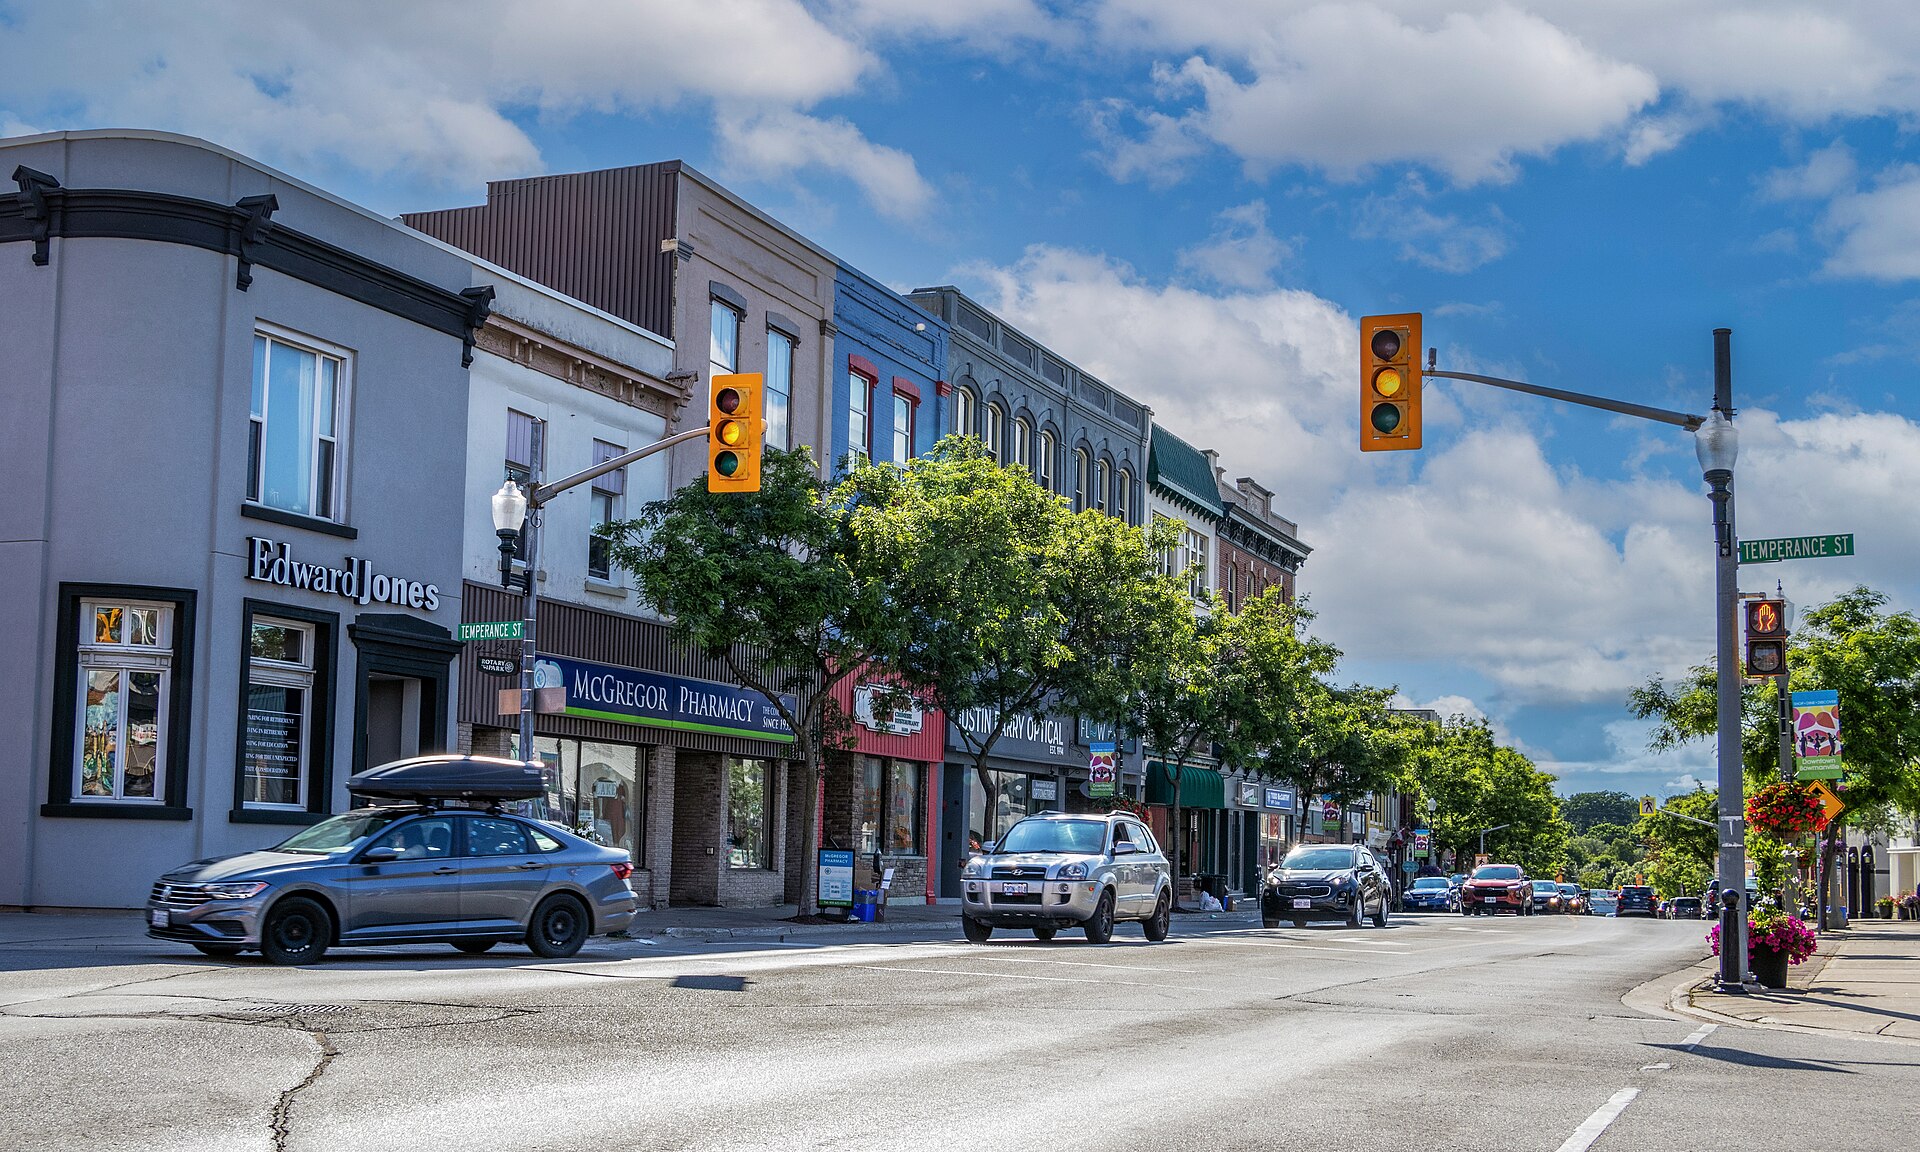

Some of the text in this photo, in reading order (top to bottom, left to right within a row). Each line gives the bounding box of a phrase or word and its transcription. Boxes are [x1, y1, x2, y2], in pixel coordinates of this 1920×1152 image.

[1743, 536, 1848, 560] TEMPERANCE ST
[461, 622, 522, 639] TEMPERANCE ST
[489, 664, 505, 672] PARK
[763, 716, 779, 730] SINCE
[1027, 716, 1064, 746] OPTICAL
